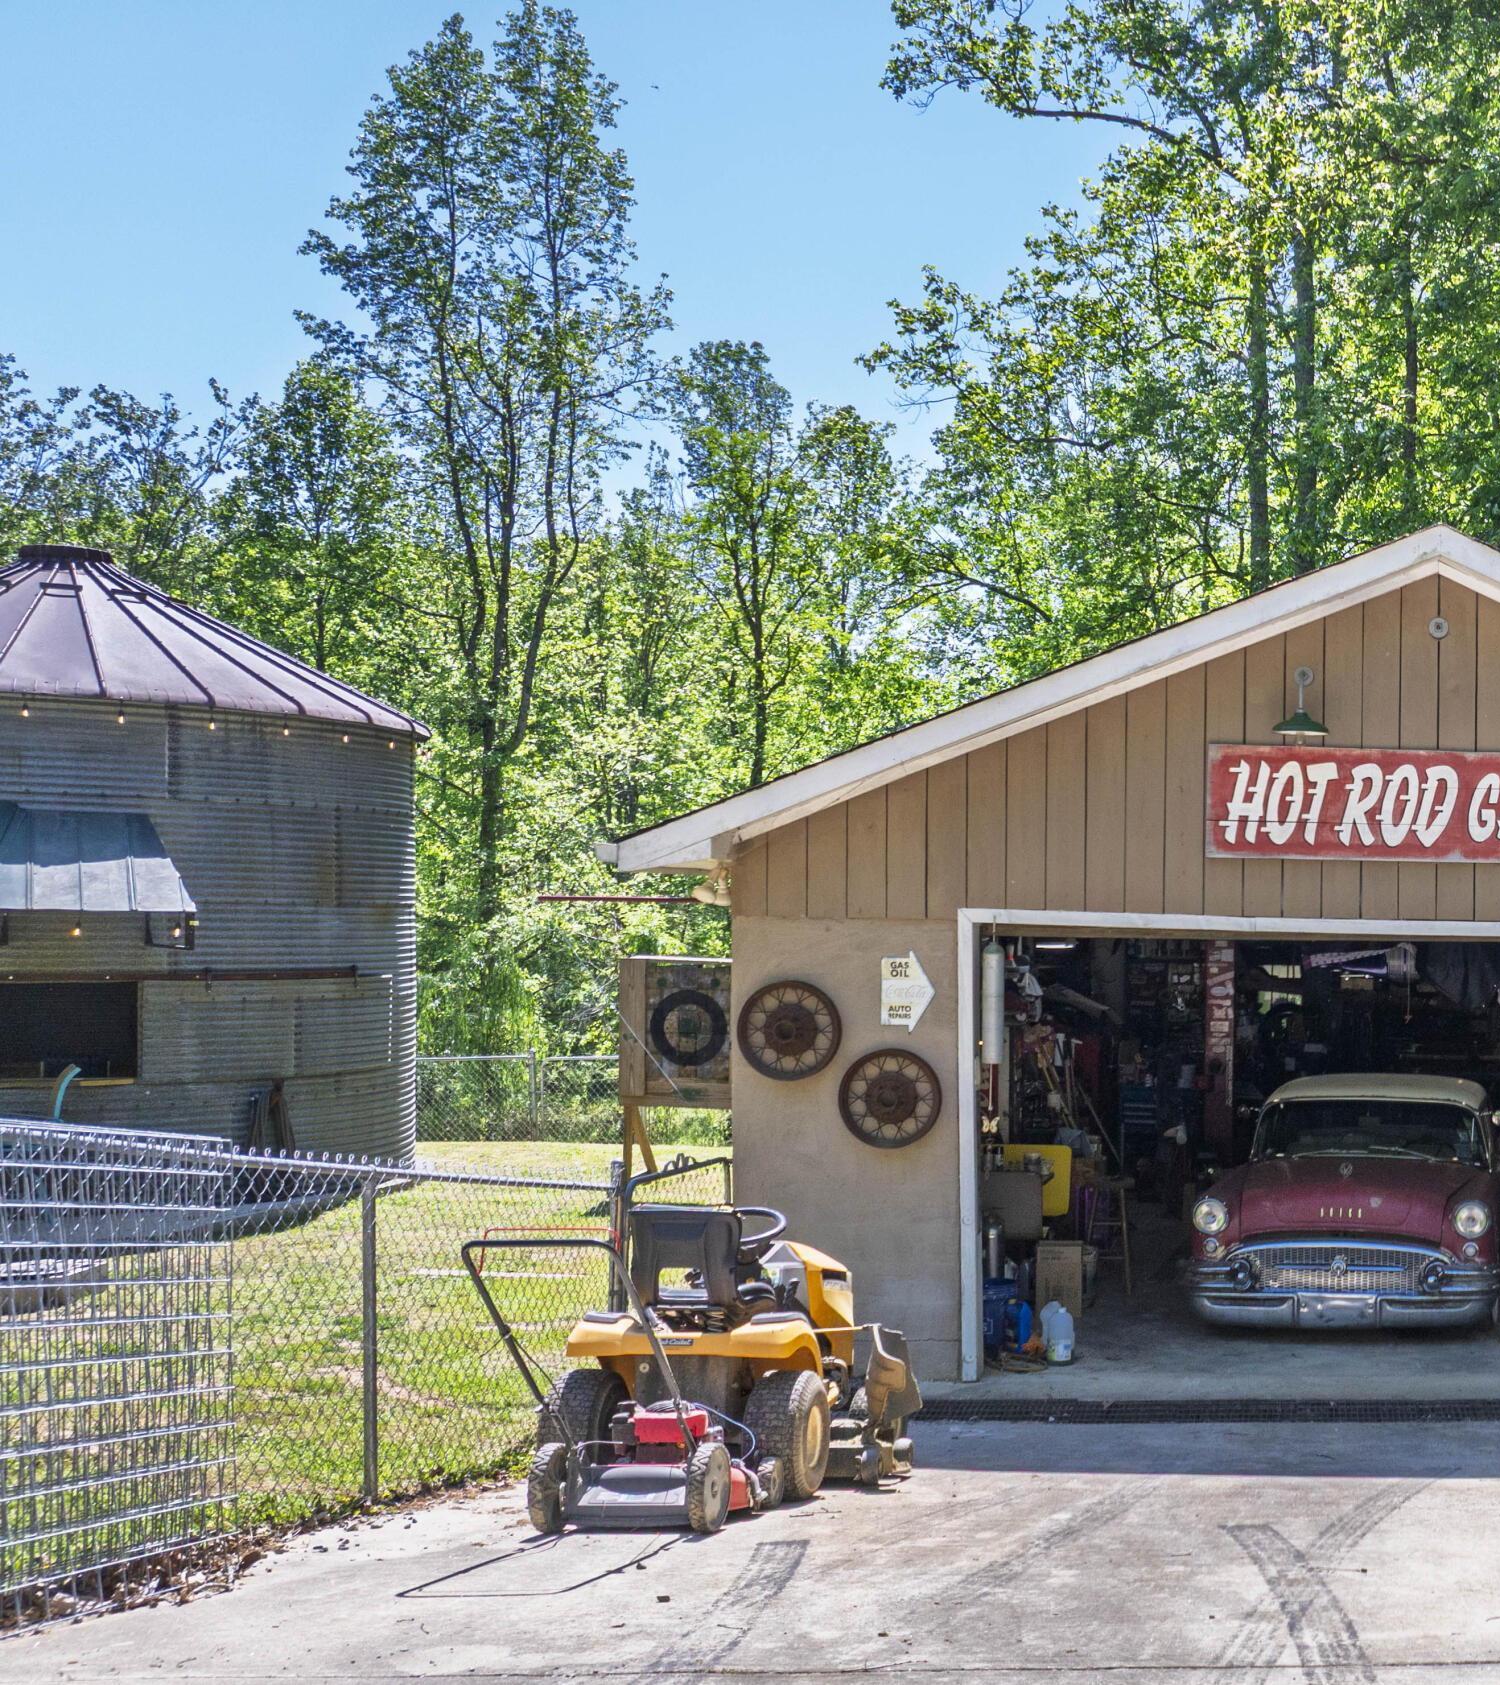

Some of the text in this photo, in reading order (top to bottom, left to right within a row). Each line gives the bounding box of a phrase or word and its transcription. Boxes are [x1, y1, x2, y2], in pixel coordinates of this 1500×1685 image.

[1219, 759, 1340, 847] HOT
[1334, 763, 1459, 848] ROD
[890, 961, 910, 970] GAS
[890, 969, 910, 978] OIL
[888, 1005, 912, 1013] AUTO
